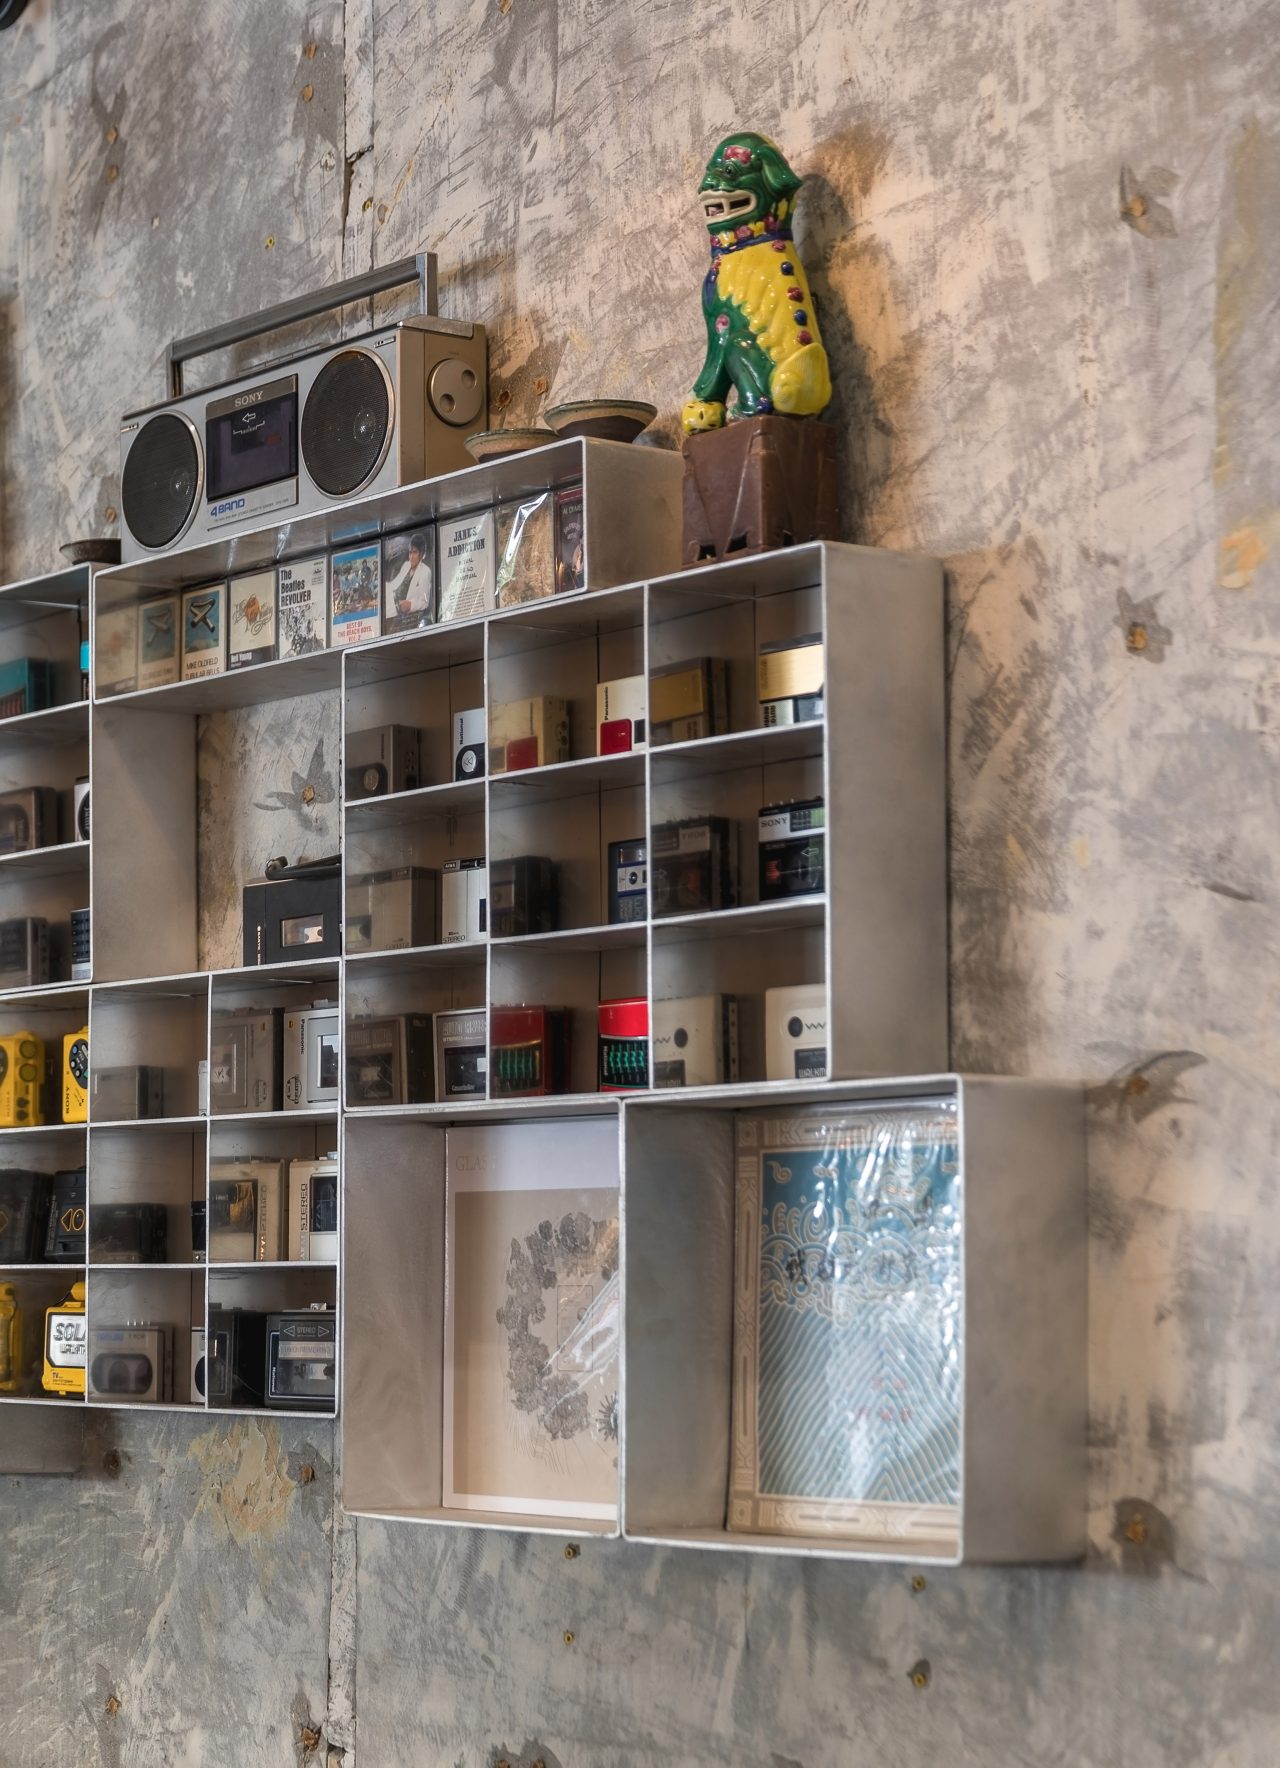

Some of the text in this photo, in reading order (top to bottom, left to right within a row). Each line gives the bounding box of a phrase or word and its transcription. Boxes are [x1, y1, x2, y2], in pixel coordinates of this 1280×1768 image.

[235, 391, 263, 408] SONY
[448, 538, 485, 558] ADDICTION
[281, 569, 292, 580] The
[281, 580, 305, 594] Beatles
[281, 590, 312, 607] REVOLVER
[346, 620, 363, 630] BEST OF
[346, 628, 360, 636] BEACH
[187, 657, 218, 669] MIKE OLDFIELD
[205, 667, 220, 677] BELLS
[761, 817, 787, 828] SONY
[442, 935, 465, 943] STEREO
